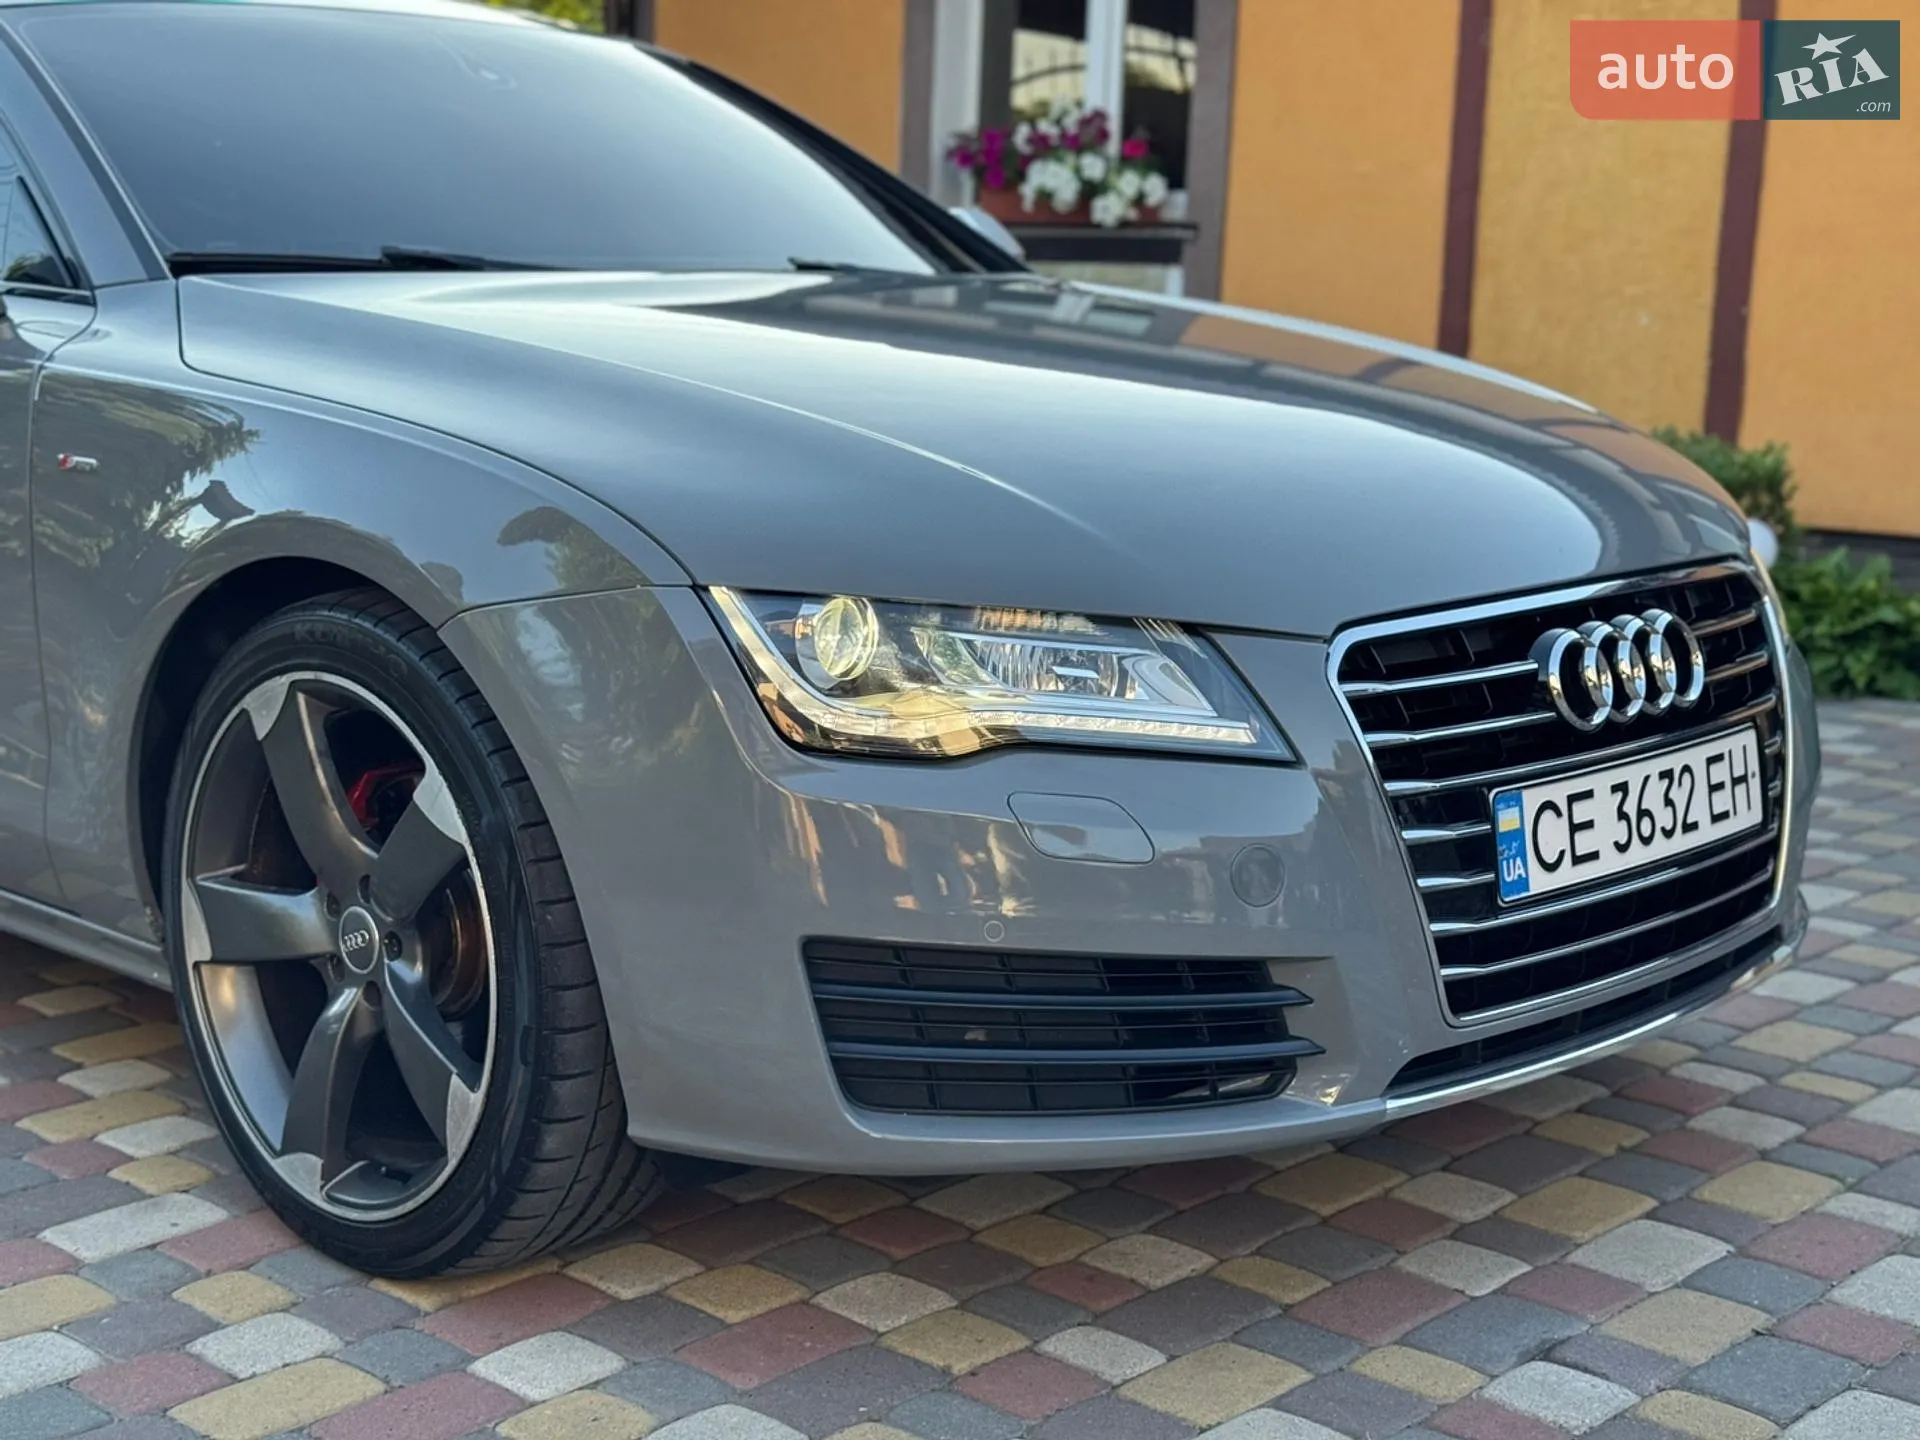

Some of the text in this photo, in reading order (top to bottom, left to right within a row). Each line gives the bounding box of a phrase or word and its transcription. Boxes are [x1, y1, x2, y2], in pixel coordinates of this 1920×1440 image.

[1531, 743, 1752, 873] CE 3632 EH
[1502, 857, 1527, 882] UA
